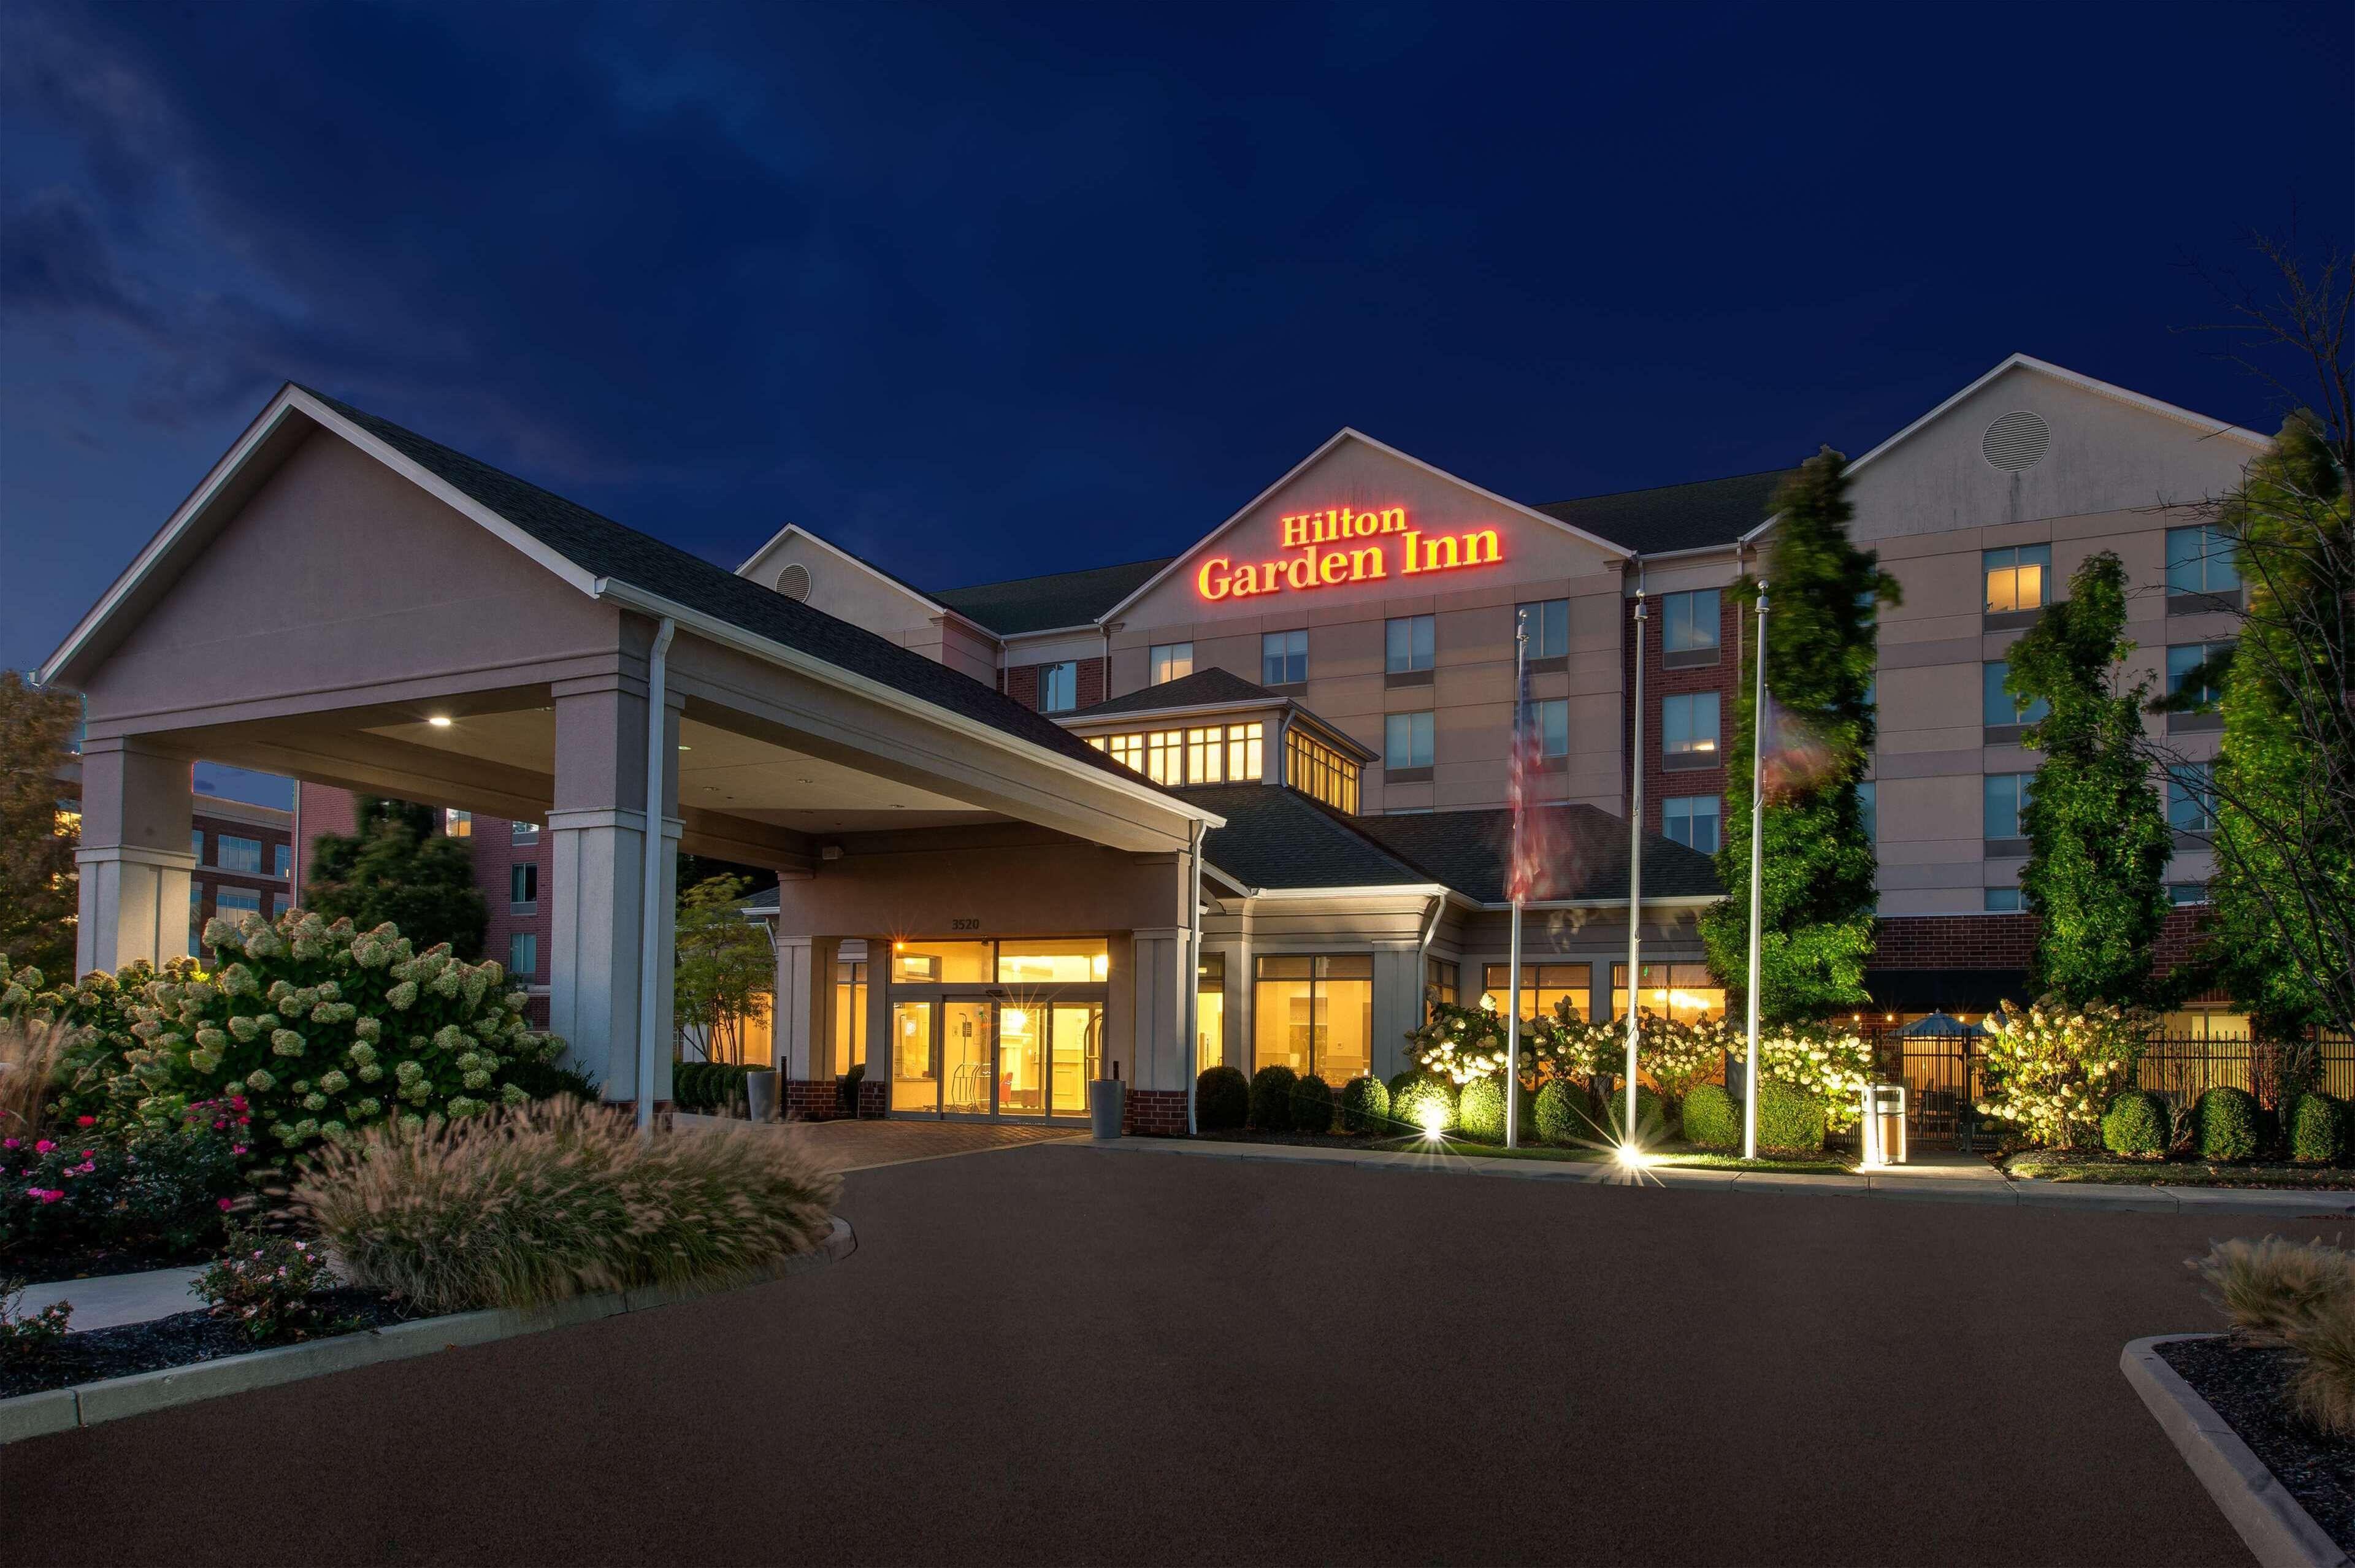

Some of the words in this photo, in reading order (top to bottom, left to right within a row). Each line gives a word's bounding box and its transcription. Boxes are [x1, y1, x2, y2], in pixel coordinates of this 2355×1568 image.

[1281, 507, 1408, 548] Hilton
[1197, 545, 1387, 600] Garden
[1401, 529, 1503, 574] Inn
[952, 919, 979, 930] 3520
